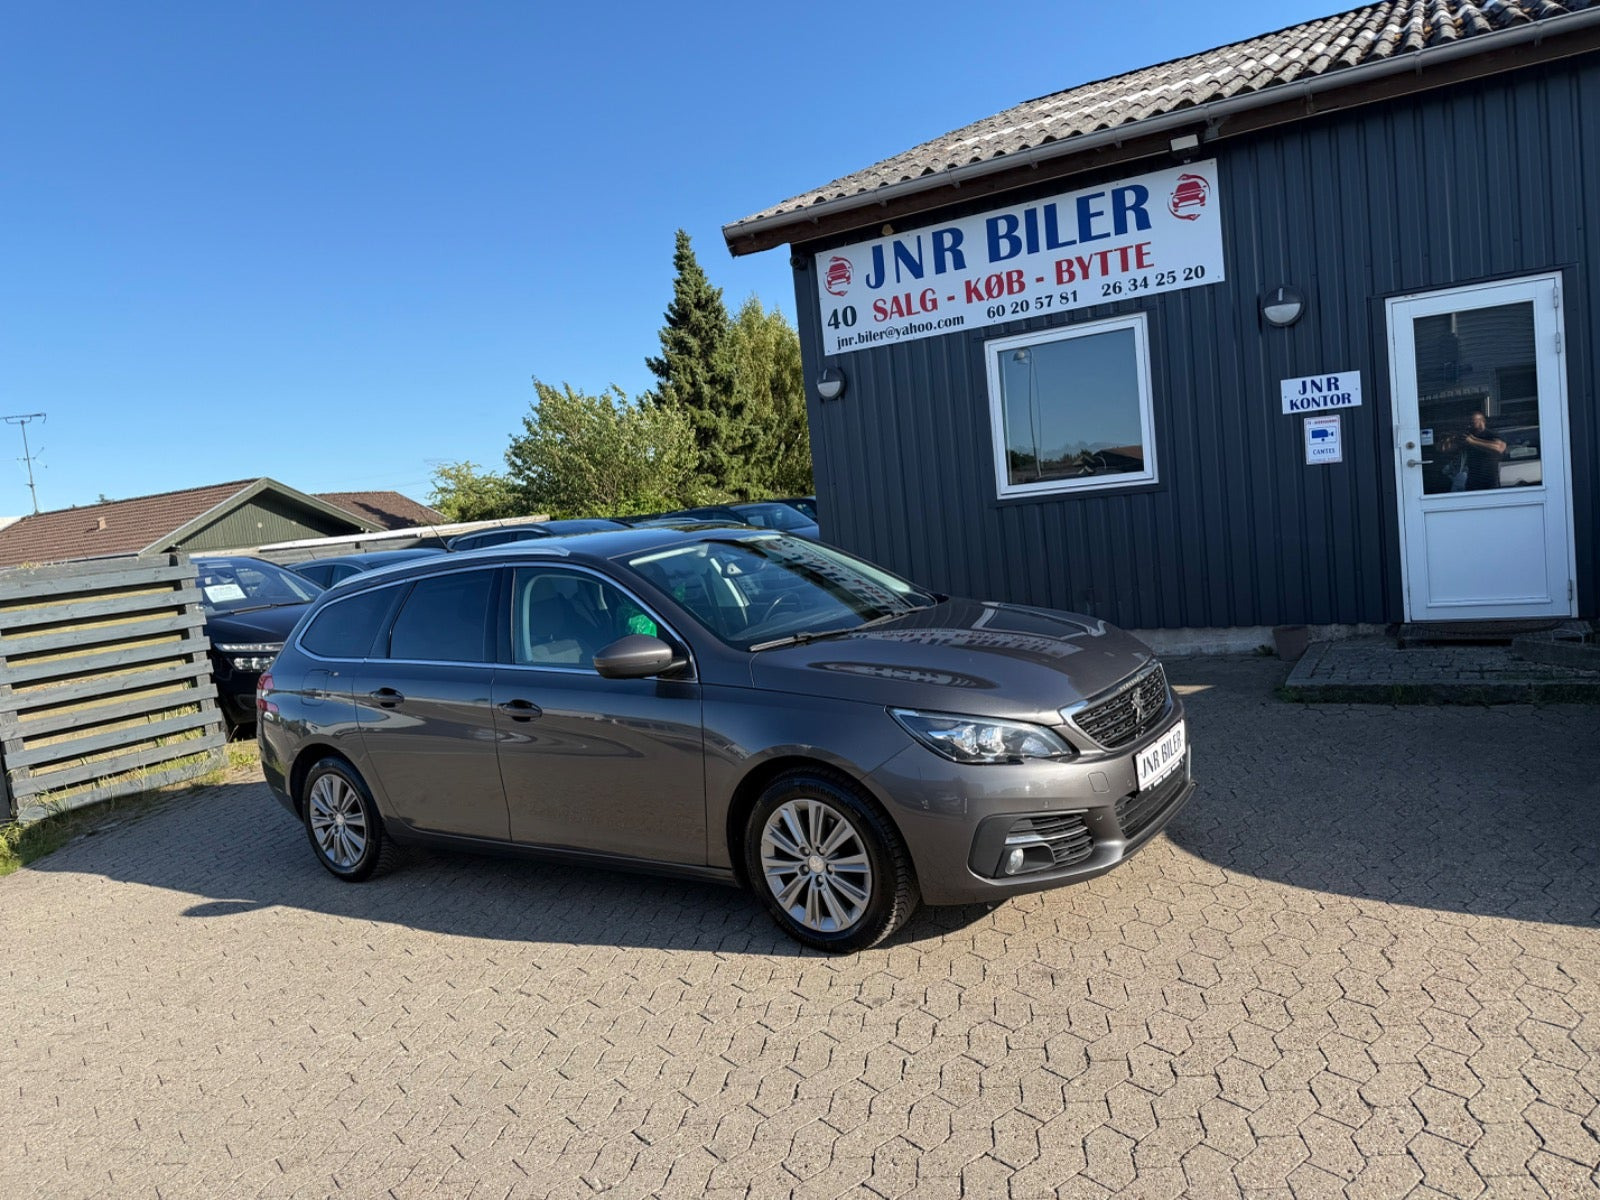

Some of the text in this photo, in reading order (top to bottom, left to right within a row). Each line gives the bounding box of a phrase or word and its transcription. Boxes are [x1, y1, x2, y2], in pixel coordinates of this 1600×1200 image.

[865, 184, 1152, 290] JNR BILER
[872, 287, 939, 323] SALG
[964, 269, 1026, 304] KØB
[1055, 241, 1155, 286] BYTTE
[1101, 265, 1206, 297] 26 34 25 20
[827, 305, 858, 330] 40
[986, 289, 1078, 319] 60 20 57 81
[837, 315, 965, 350] jnr.biler@yahoo.com
[1289, 392, 1352, 411] KONTOR
[1298, 376, 1340, 396] JNR
[1140, 730, 1182, 779] JNR BILER
